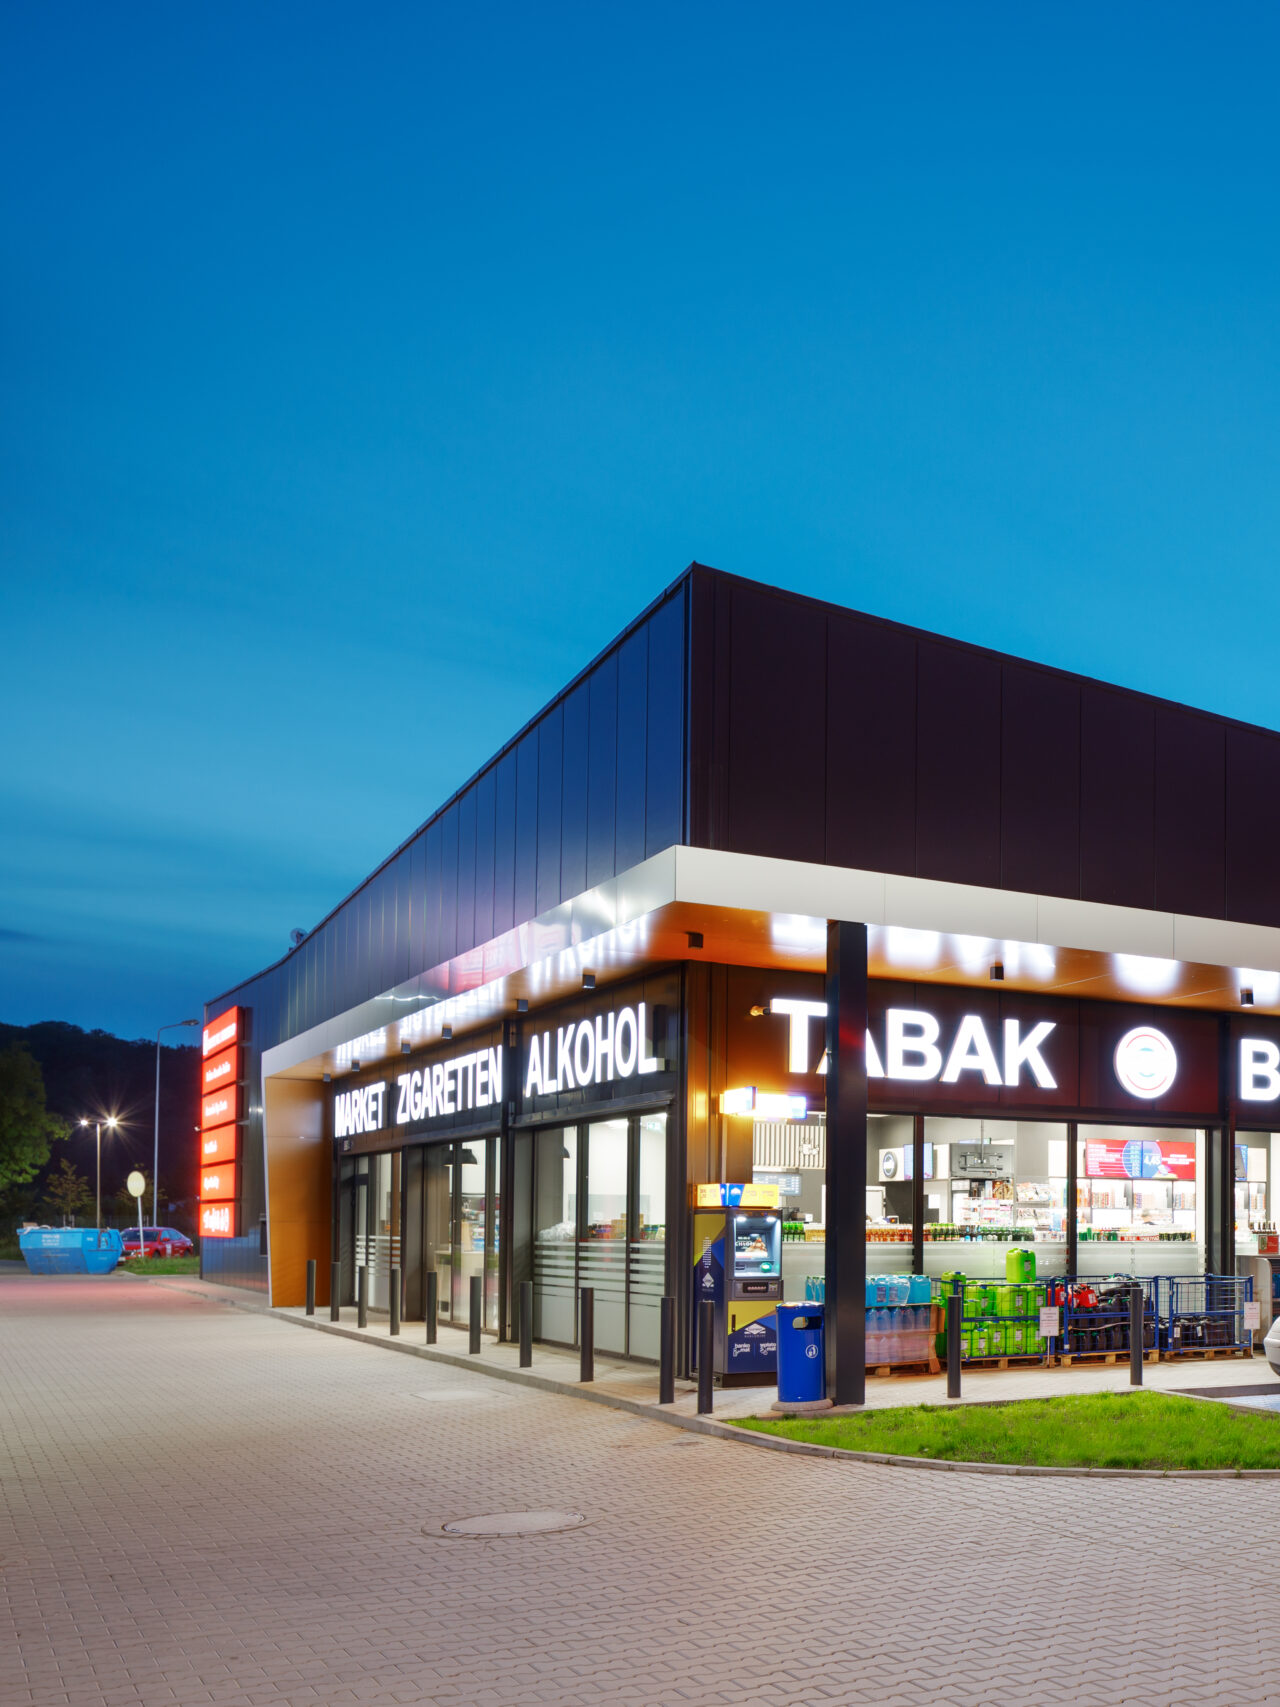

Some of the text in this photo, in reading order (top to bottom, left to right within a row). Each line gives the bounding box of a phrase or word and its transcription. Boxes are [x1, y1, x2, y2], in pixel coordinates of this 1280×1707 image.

[335, 1002, 658, 1138] MARKET ZIGARETTEN ALKOHOL
